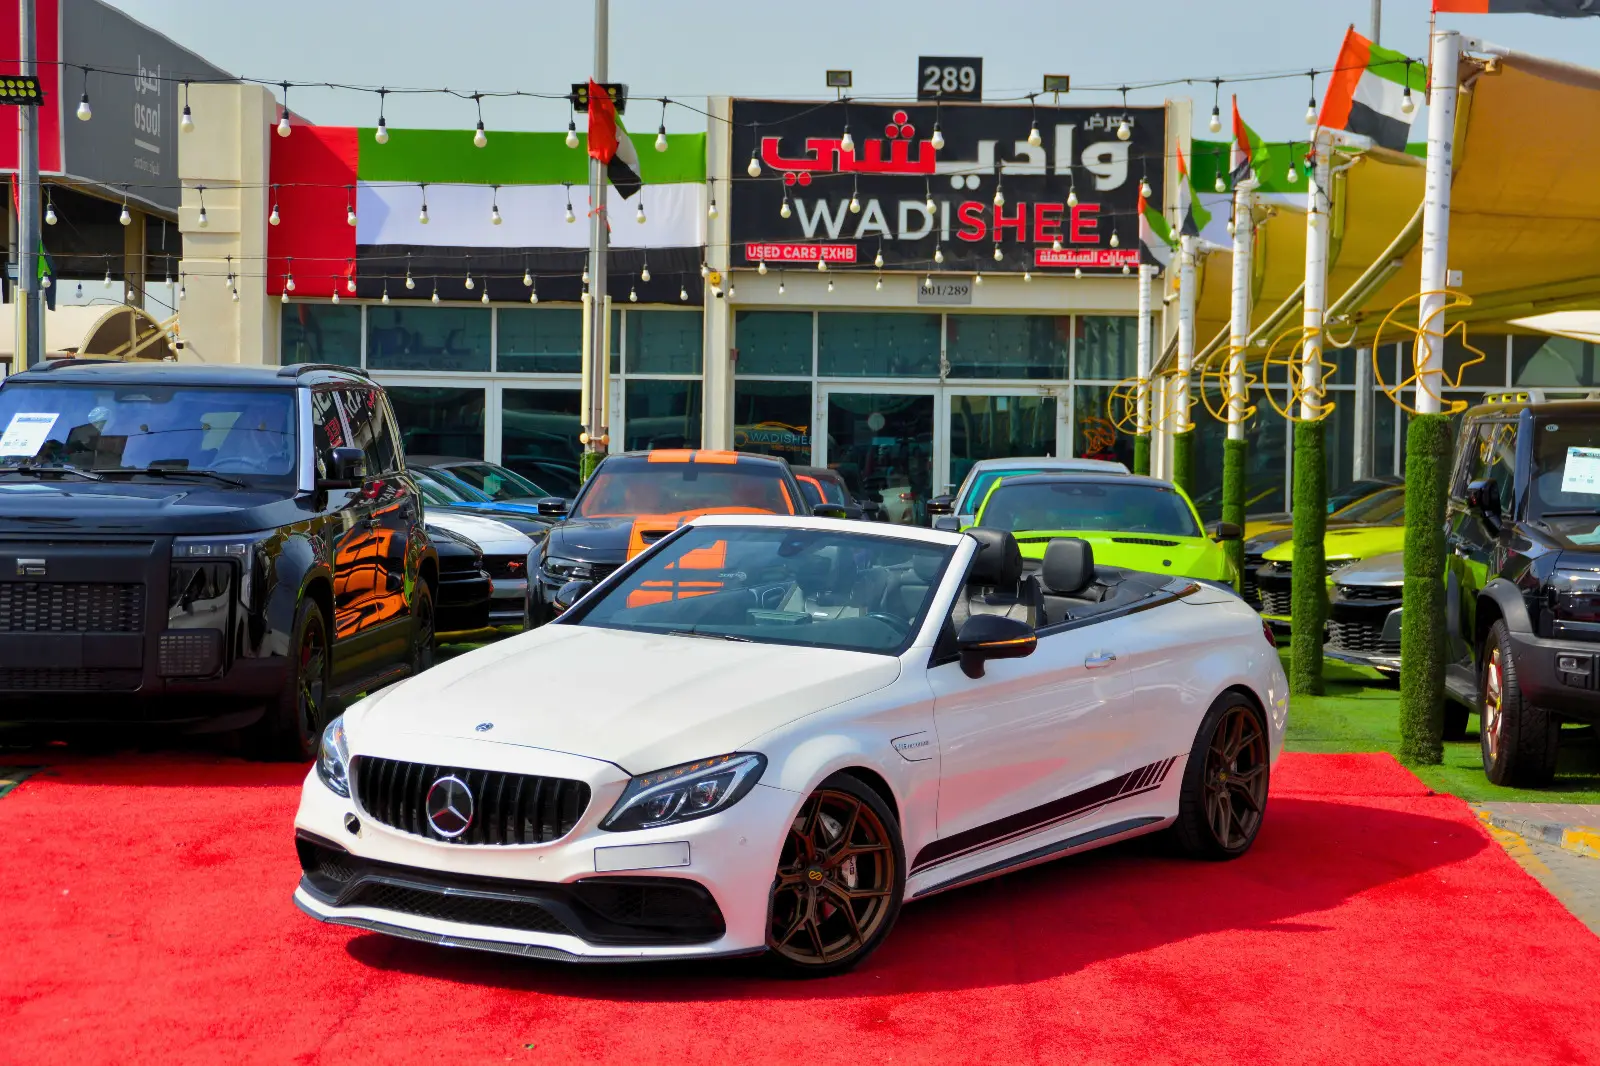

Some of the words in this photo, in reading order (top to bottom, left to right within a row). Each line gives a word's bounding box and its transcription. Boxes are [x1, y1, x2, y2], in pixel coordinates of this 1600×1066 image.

[923, 65, 976, 92] 289
[793, 198, 1100, 243] WADISHEE
[747, 246, 780, 258] USED
[783, 247, 817, 259] CARS
[821, 247, 855, 260] EXHB
[921, 285, 969, 296] 801/289
